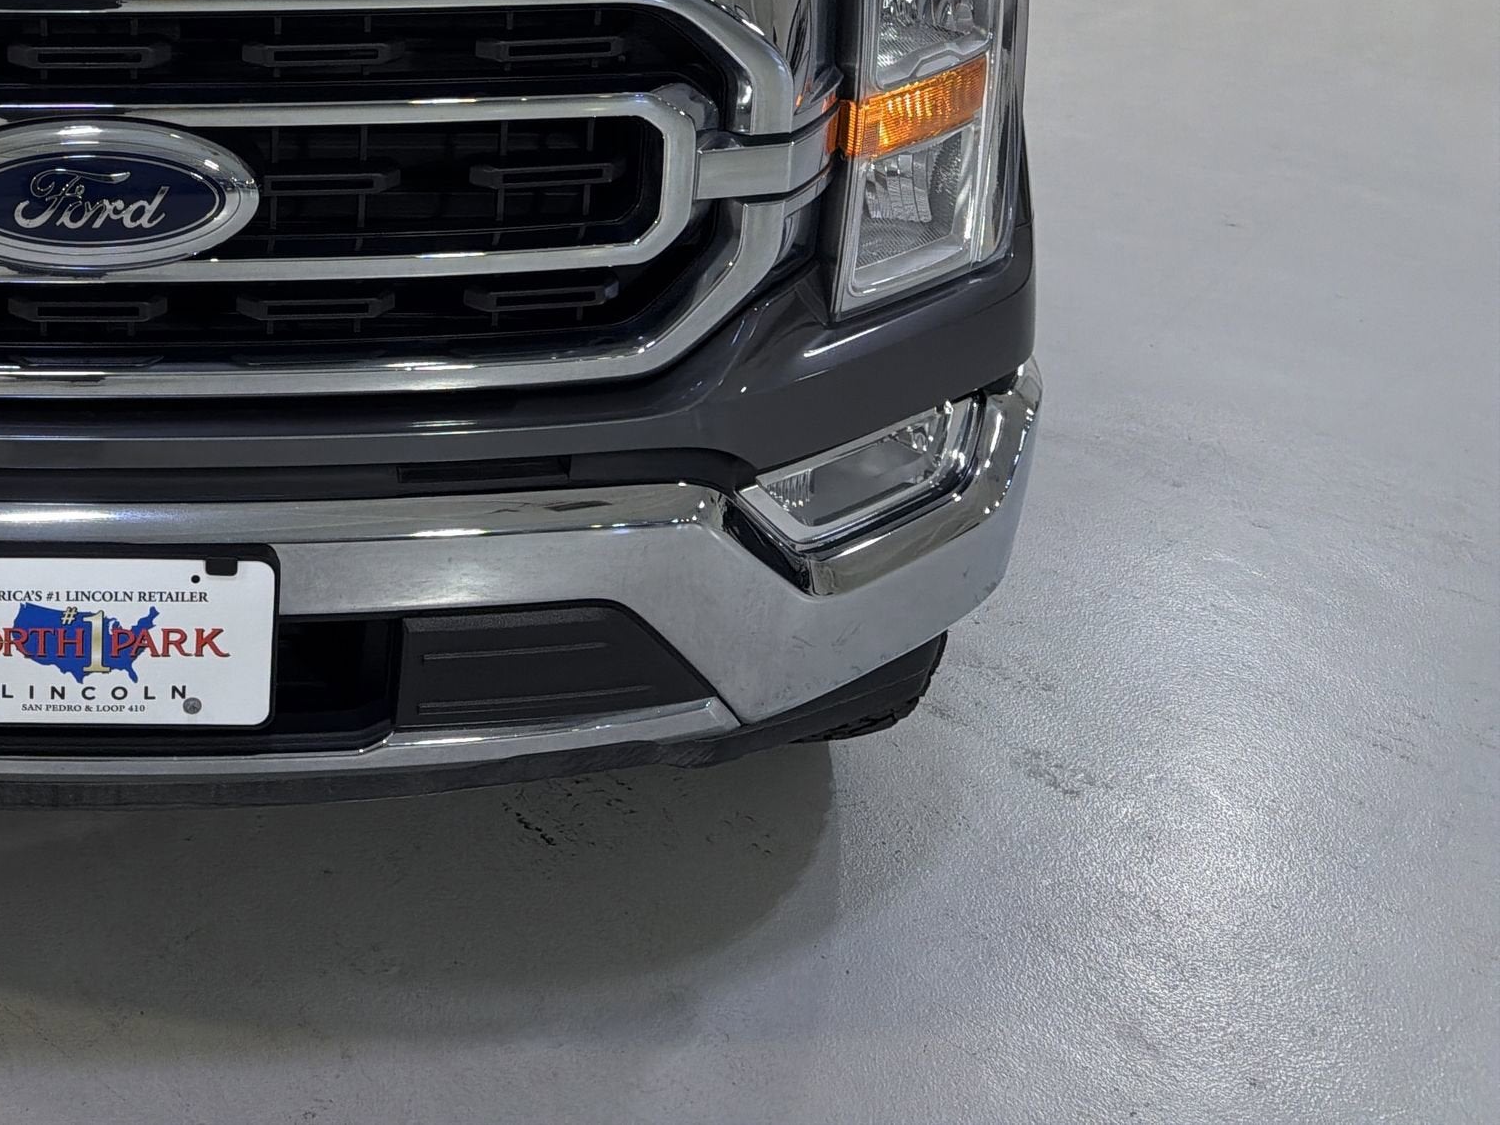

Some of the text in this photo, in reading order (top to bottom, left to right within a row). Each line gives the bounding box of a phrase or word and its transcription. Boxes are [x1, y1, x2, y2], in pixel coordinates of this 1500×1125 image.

[14, 168, 171, 229] Ford
[46, 590, 61, 602] #1
[65, 590, 134, 603] LINCOLN
[138, 591, 209, 603] RETAILER
[110, 628, 231, 658] PARK
[1, 684, 187, 700] LINCOLN
[21, 703, 146, 713] SAN PEDRO & LOOP 410
